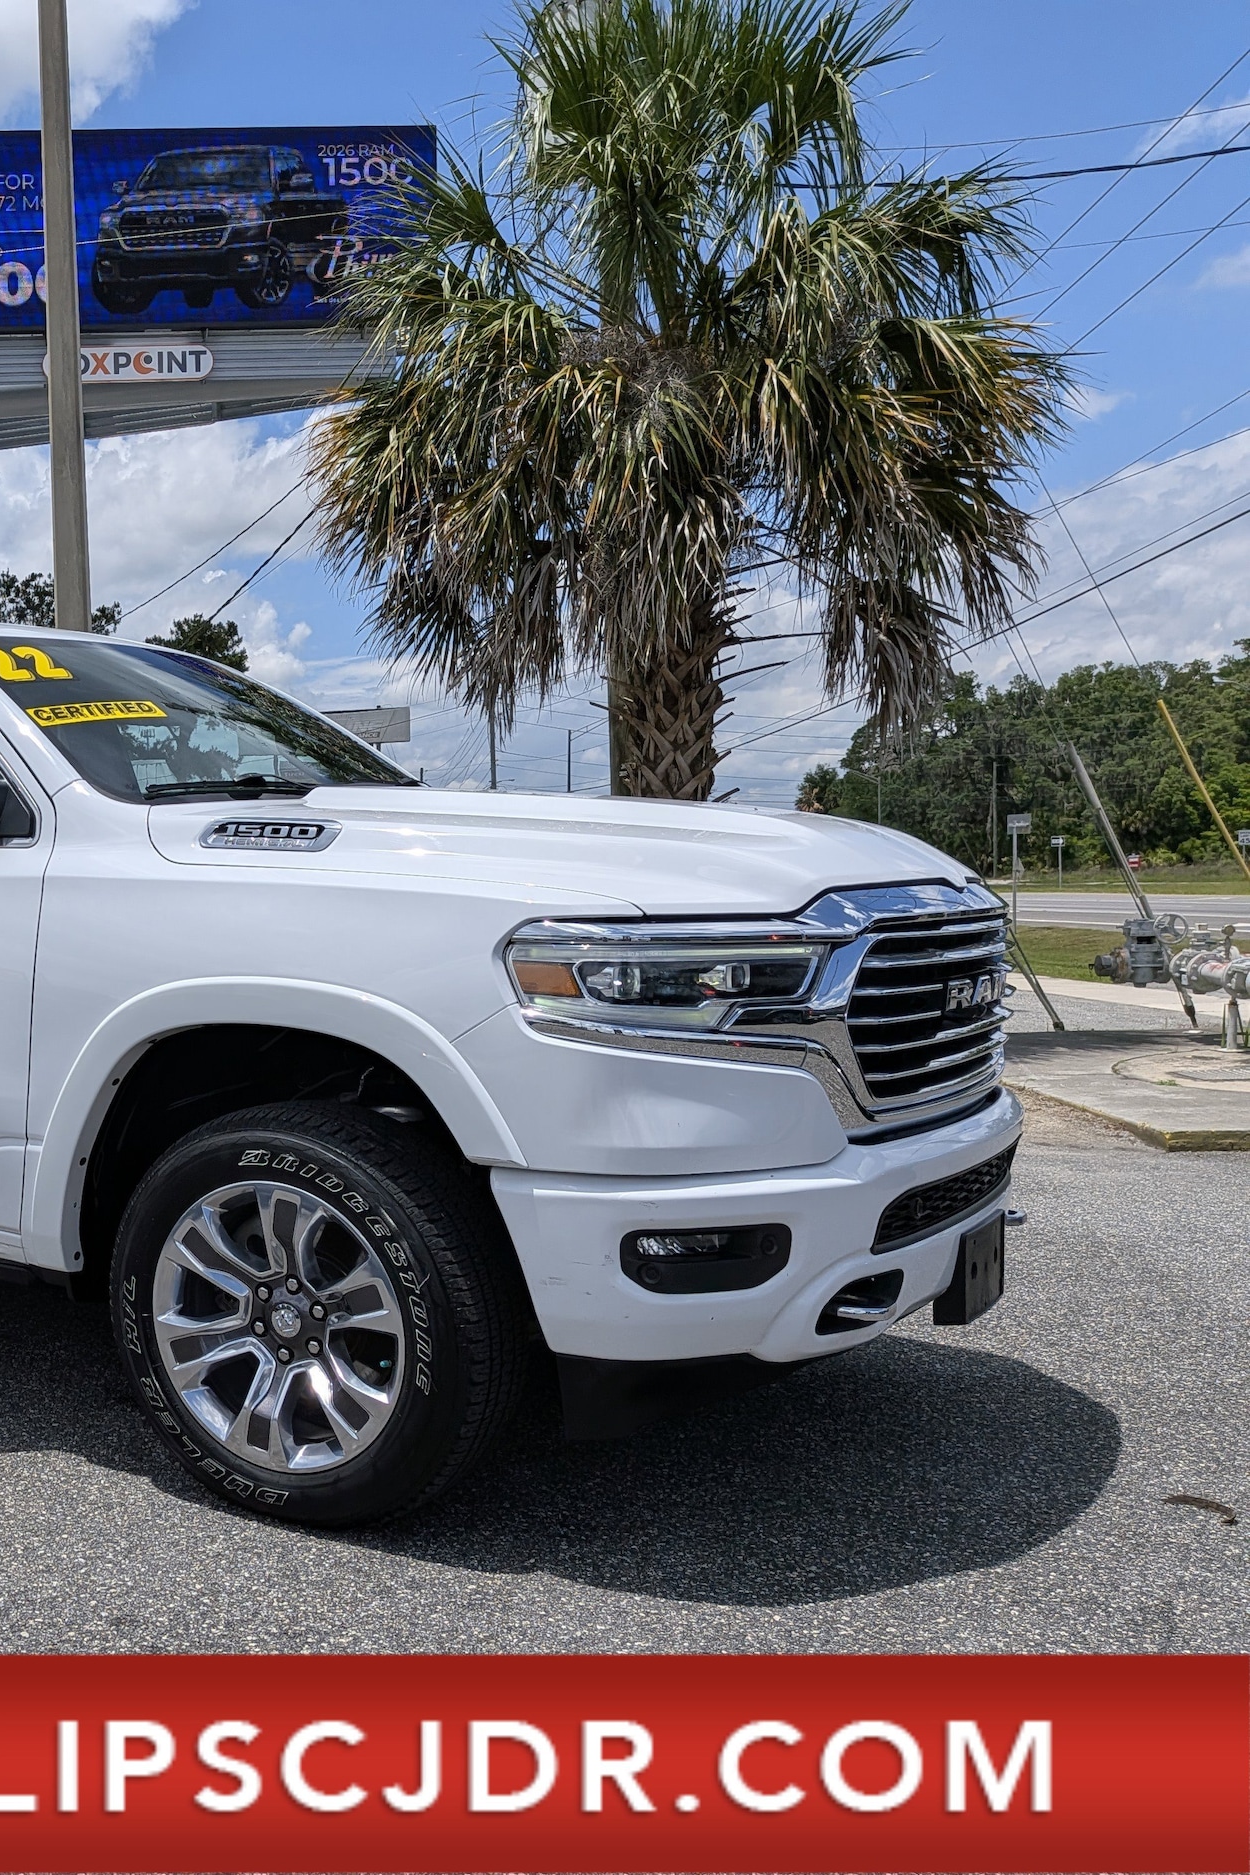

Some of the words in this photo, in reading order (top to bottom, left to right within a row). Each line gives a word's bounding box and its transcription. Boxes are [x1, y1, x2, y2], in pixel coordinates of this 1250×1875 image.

[317, 144, 355, 157] 2026
[358, 143, 395, 157] RAM
[22, 194, 44, 212] M
[33, 701, 156, 723] CERTIFIED
[215, 824, 318, 839] 1500
[237, 1148, 434, 1397] BRIDGESTONE
[122, 1275, 142, 1355] H/L
[139, 1377, 291, 1507] DUELER
